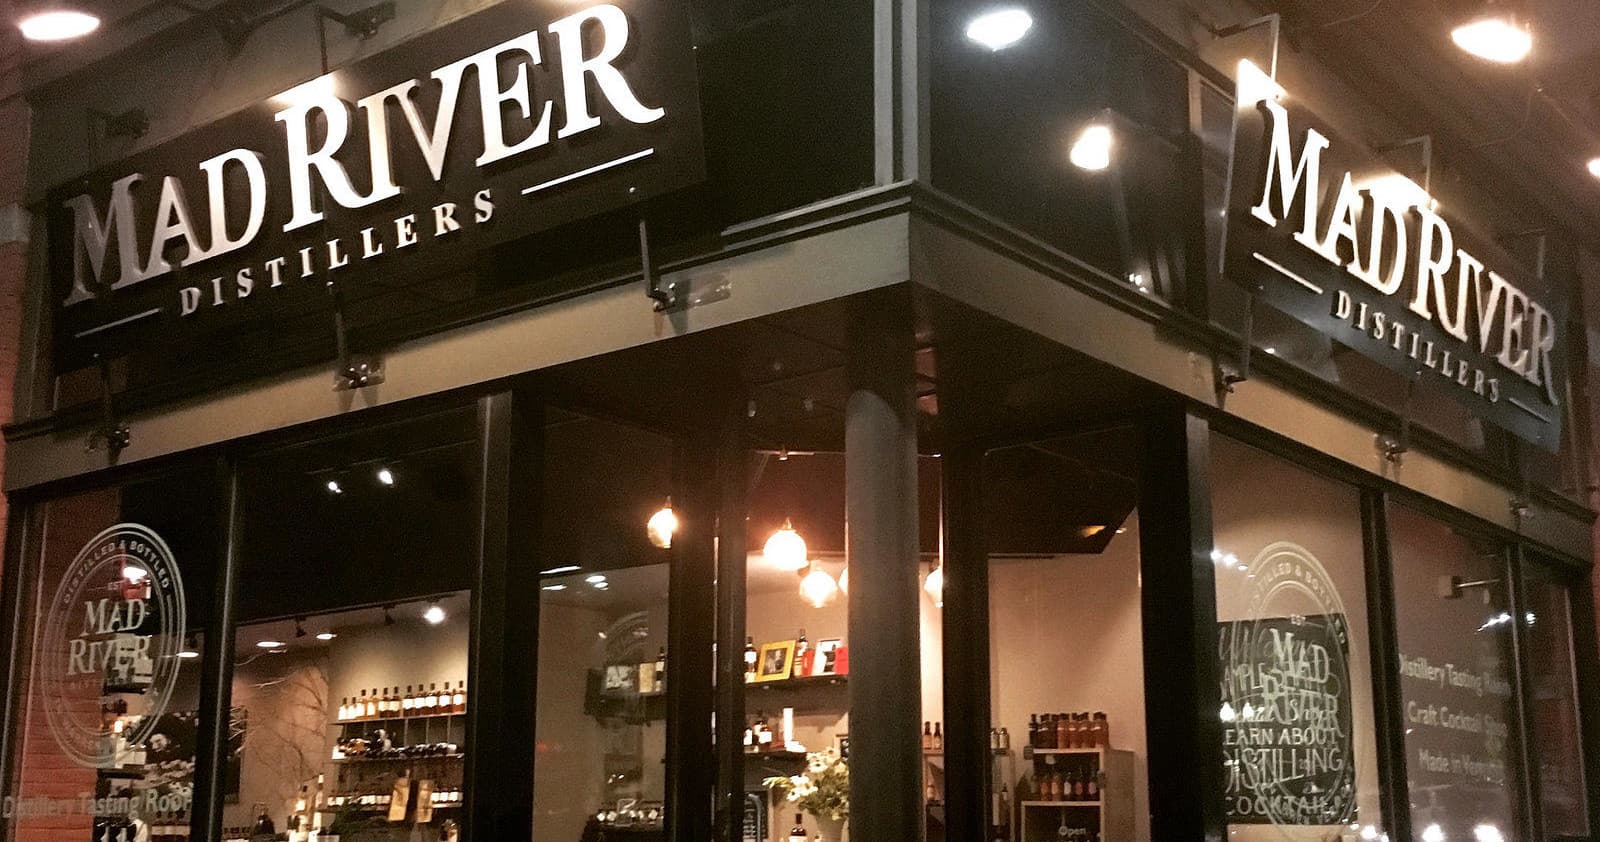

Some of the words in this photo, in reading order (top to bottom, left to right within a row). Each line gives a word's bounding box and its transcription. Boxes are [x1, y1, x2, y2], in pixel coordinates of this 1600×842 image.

[62, 148, 269, 307] MAD
[274, 3, 665, 233] RIVER
[179, 189, 497, 318] DISTILLERS
[1251, 99, 1408, 296] MAD
[1409, 203, 1558, 406] RIVER
[1335, 290, 1500, 404] DISTILLERS
[128, 540, 171, 589] BOTTLED
[79, 598, 148, 638] MAD
[67, 634, 151, 676] RIVER
[1269, 627, 1331, 684] MAD
[1262, 672, 1345, 739] RIVER
